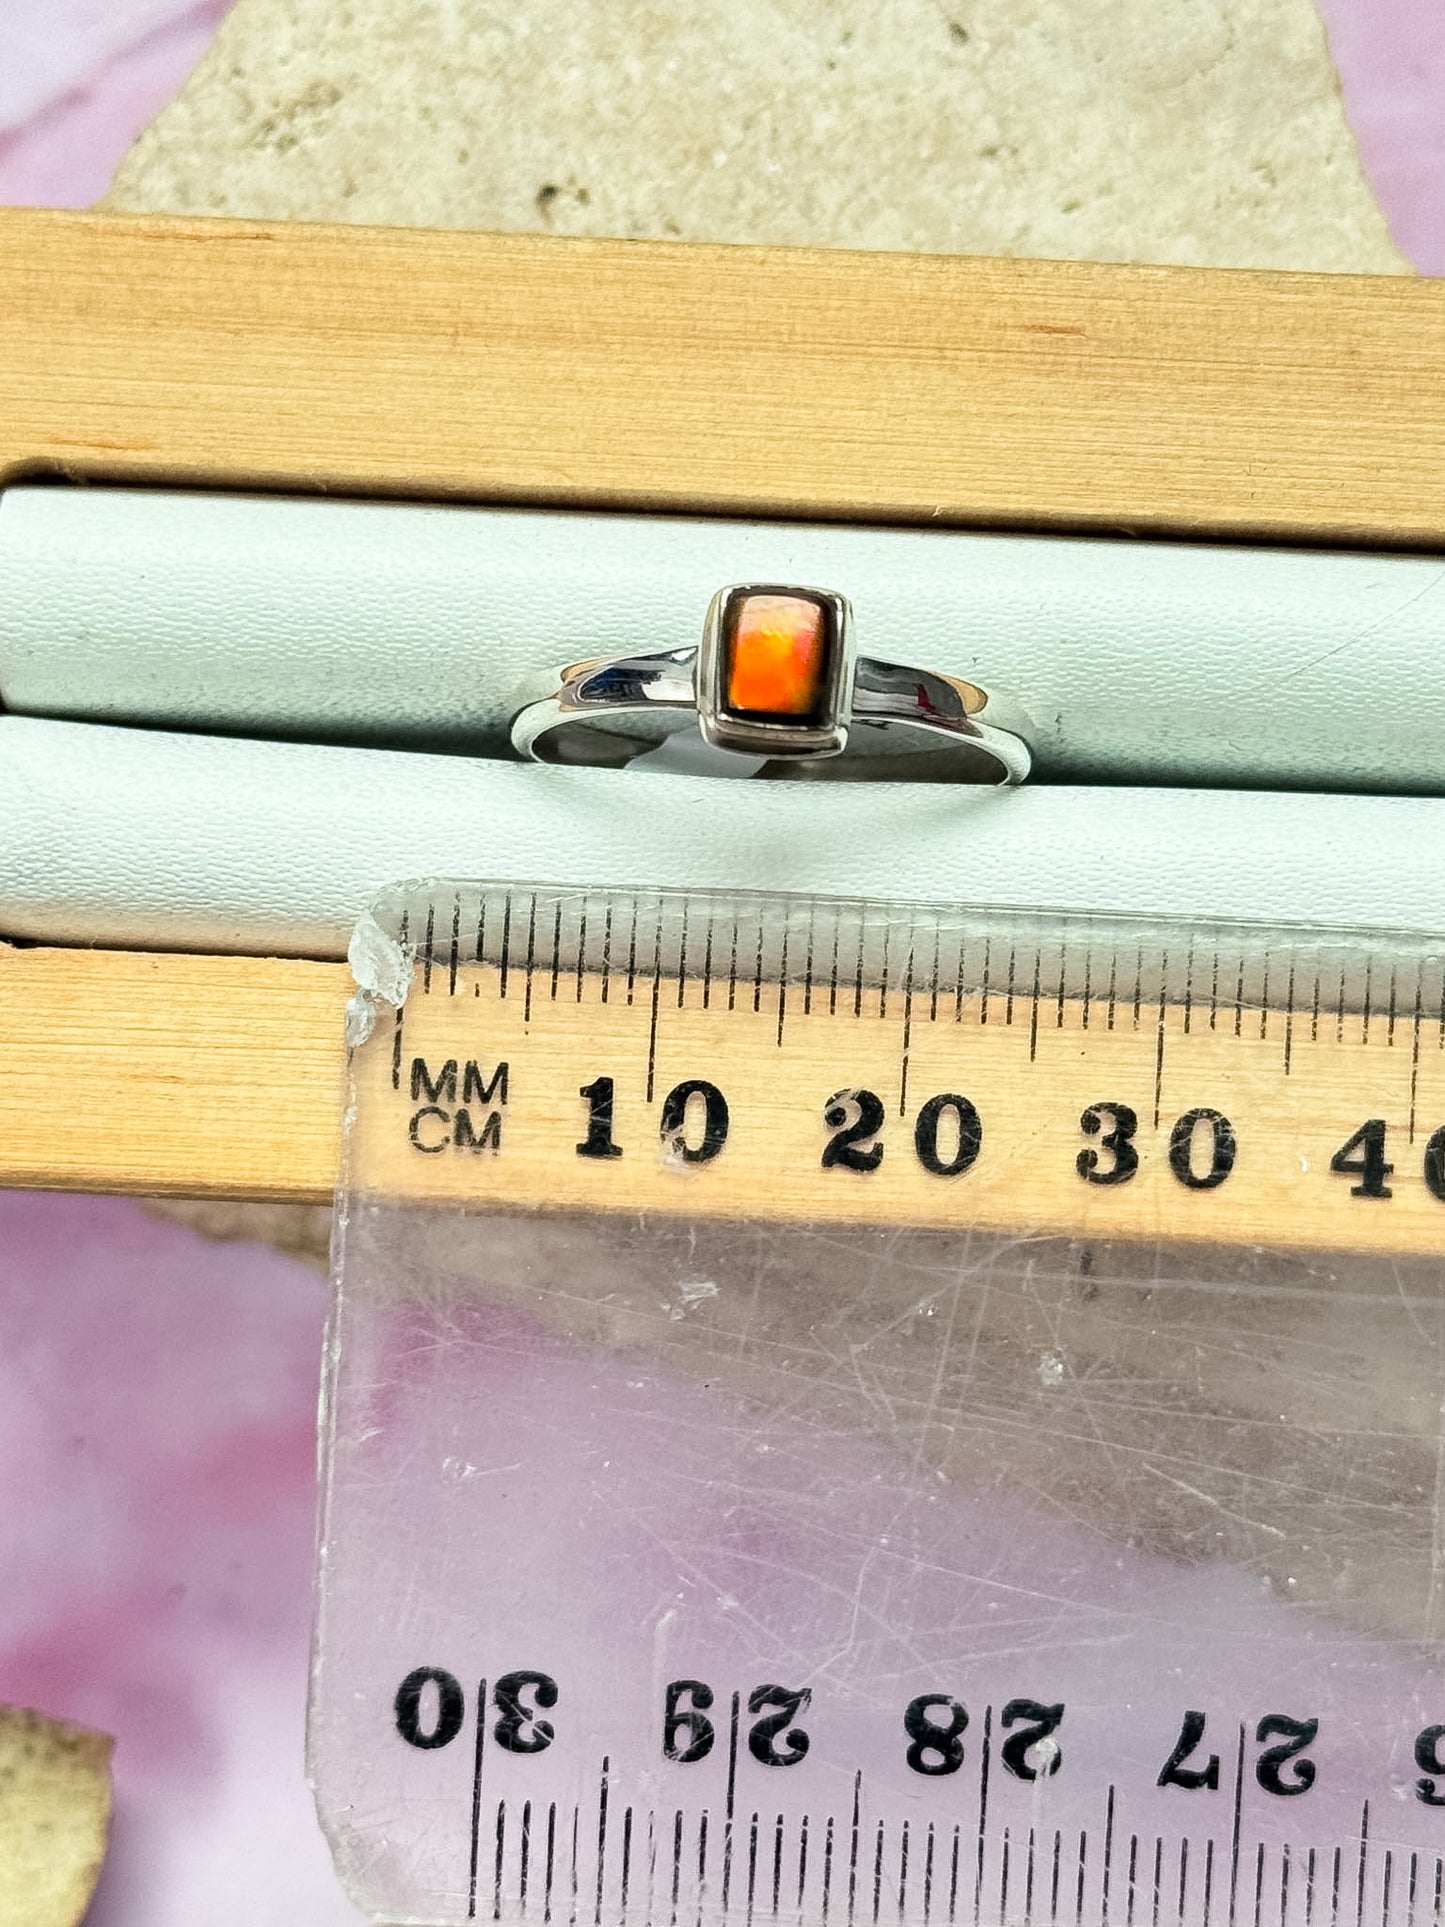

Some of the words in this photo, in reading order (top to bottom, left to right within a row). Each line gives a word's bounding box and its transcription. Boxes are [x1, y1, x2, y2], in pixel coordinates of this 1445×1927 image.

[410, 1057, 509, 1105] MM
[408, 1106, 502, 1156] CM
[575, 1077, 730, 1165] 10
[821, 1087, 982, 1176] 20
[1076, 1102, 1237, 1190] 30
